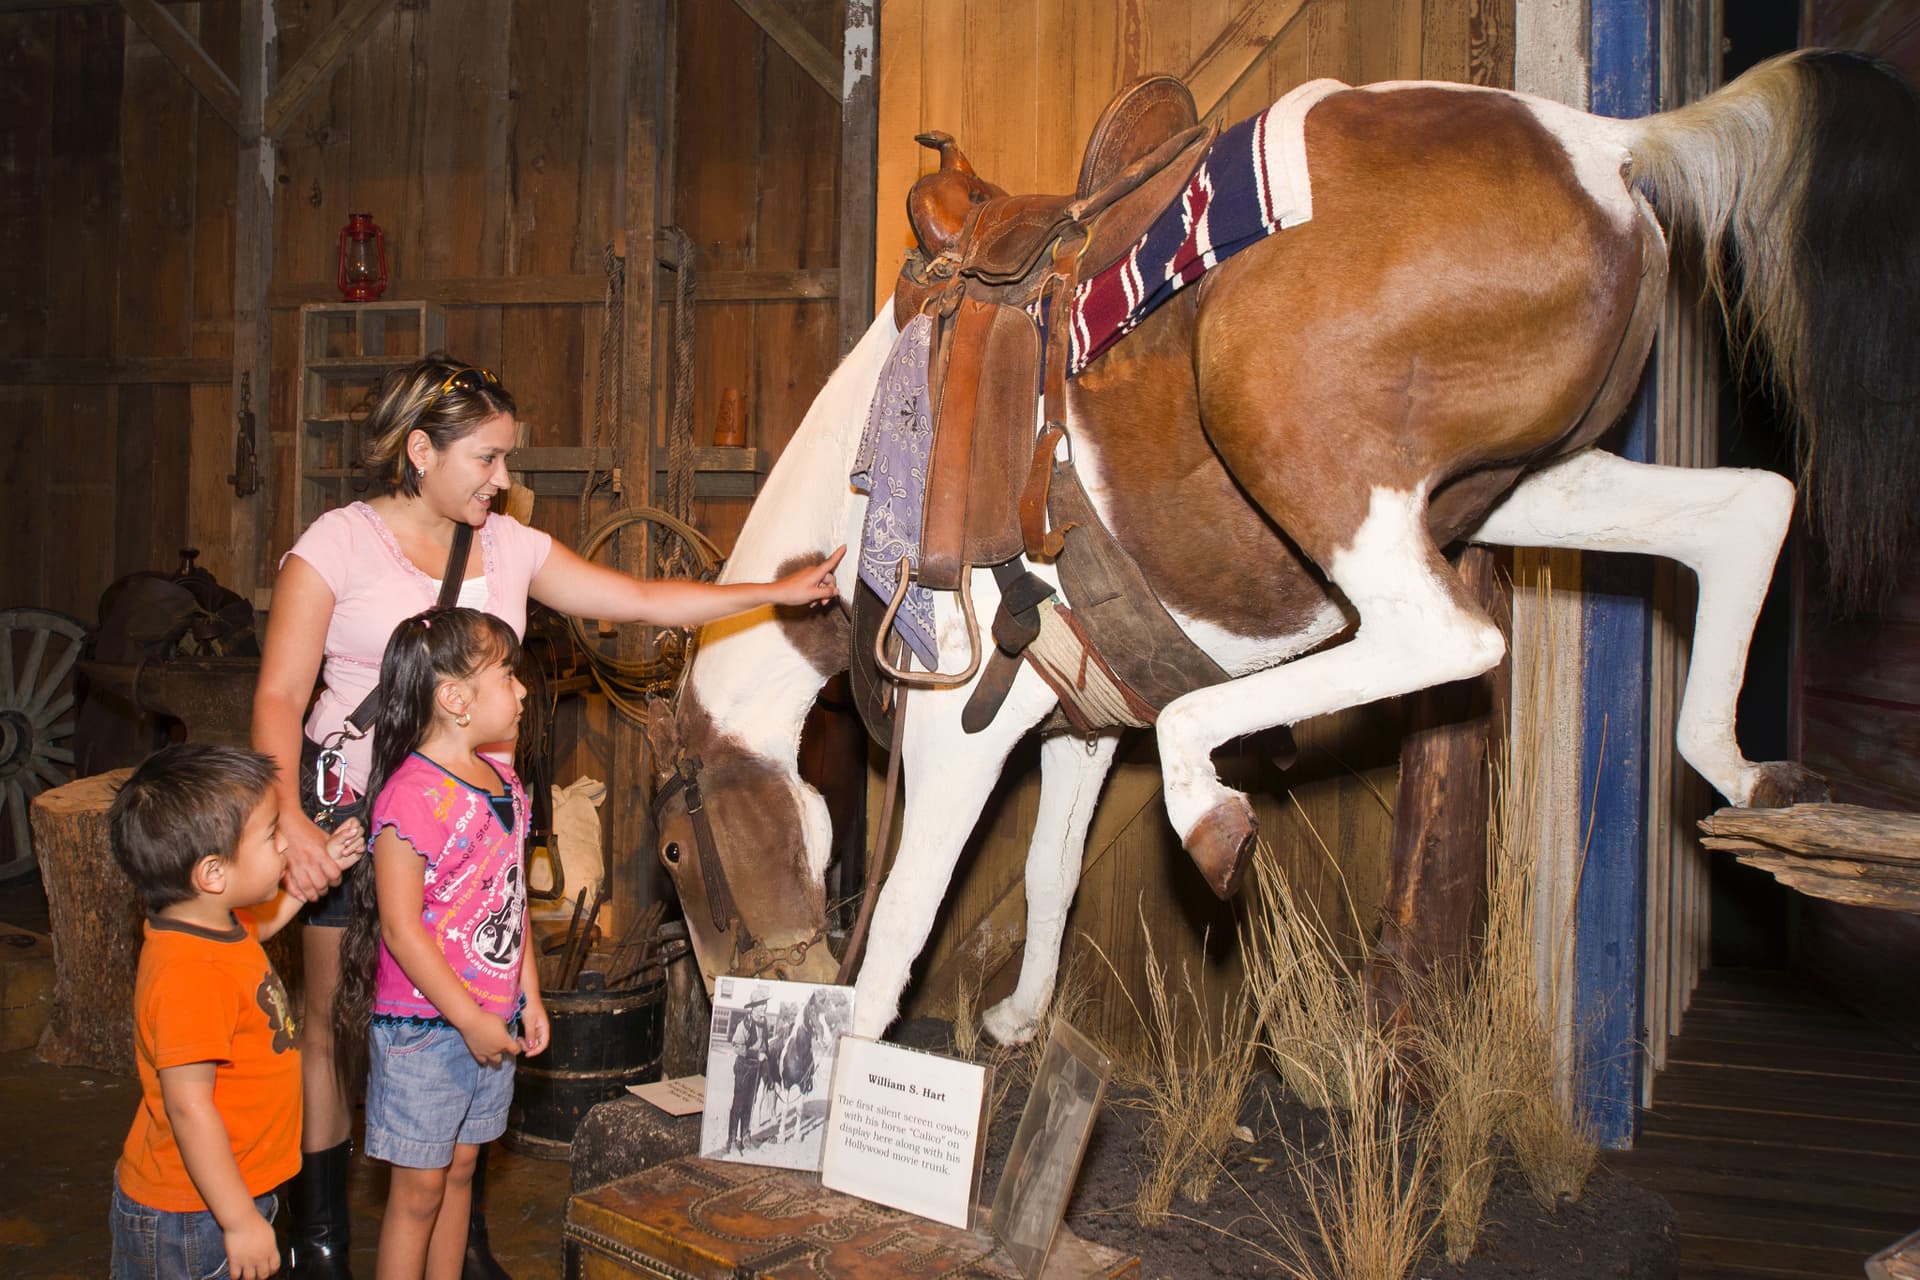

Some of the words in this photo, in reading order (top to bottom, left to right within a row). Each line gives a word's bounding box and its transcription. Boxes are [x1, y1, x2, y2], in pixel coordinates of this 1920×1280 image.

[868, 1074, 906, 1092] William
[909, 1085, 919, 1095] S.
[923, 1088, 946, 1102] Hart
[838, 1094, 853, 1106] The
[856, 1099, 874, 1113] first
[876, 1106, 901, 1119] silent
[903, 1114, 933, 1129] screen
[936, 1121, 971, 1138] cowboy
[844, 1111, 863, 1122] with
[865, 1116, 879, 1127] his
[881, 1120, 906, 1135] horse
[947, 1140, 960, 1149] on
[839, 1122, 871, 1141] display
[873, 1131, 893, 1145] here
[895, 1138, 921, 1154] along
[923, 1145, 943, 1159] with
[946, 1151, 960, 1163] his
[844, 1137, 890, 1158] Hollywood
[892, 1152, 919, 1166] movie
[921, 1159, 951, 1176] trunk.
